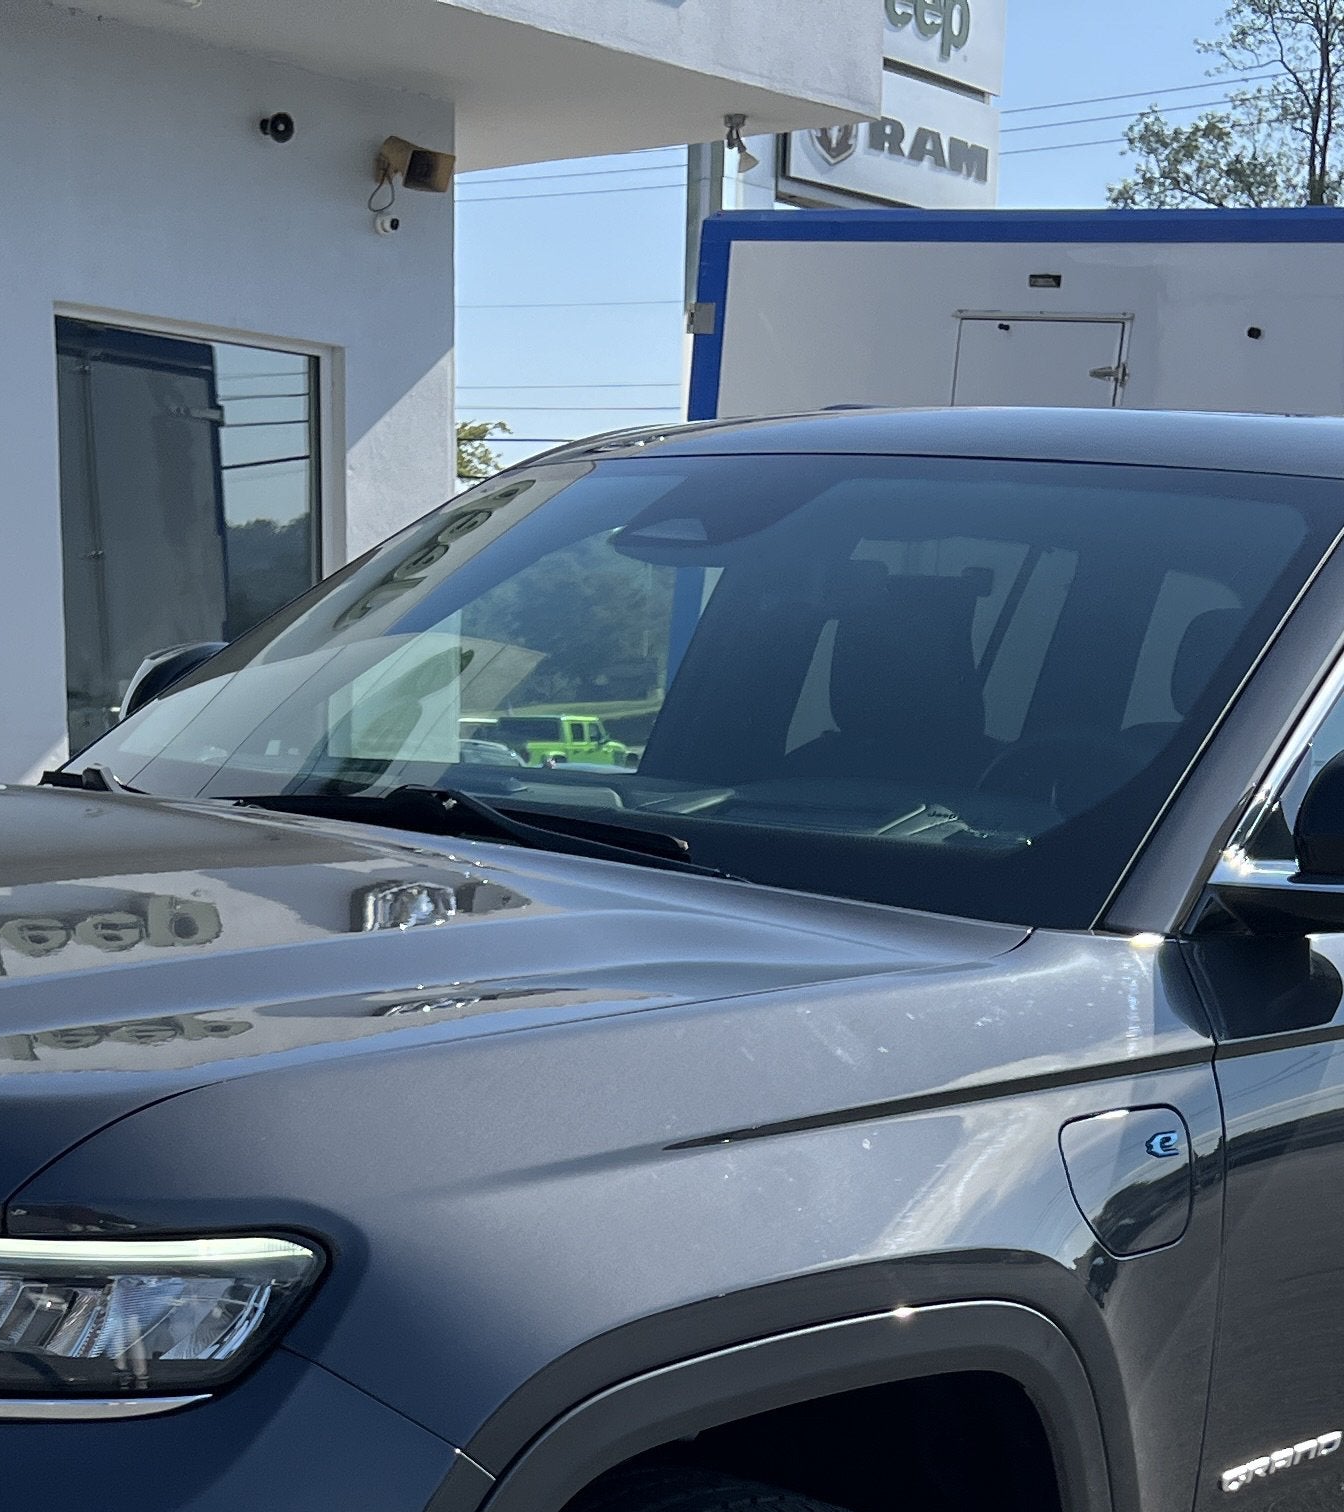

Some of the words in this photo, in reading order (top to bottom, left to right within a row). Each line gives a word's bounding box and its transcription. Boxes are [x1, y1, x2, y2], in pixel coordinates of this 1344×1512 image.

[884, 0, 970, 58] eep
[869, 116, 989, 183] RAM
[1221, 1430, 1343, 1492] GRAND
